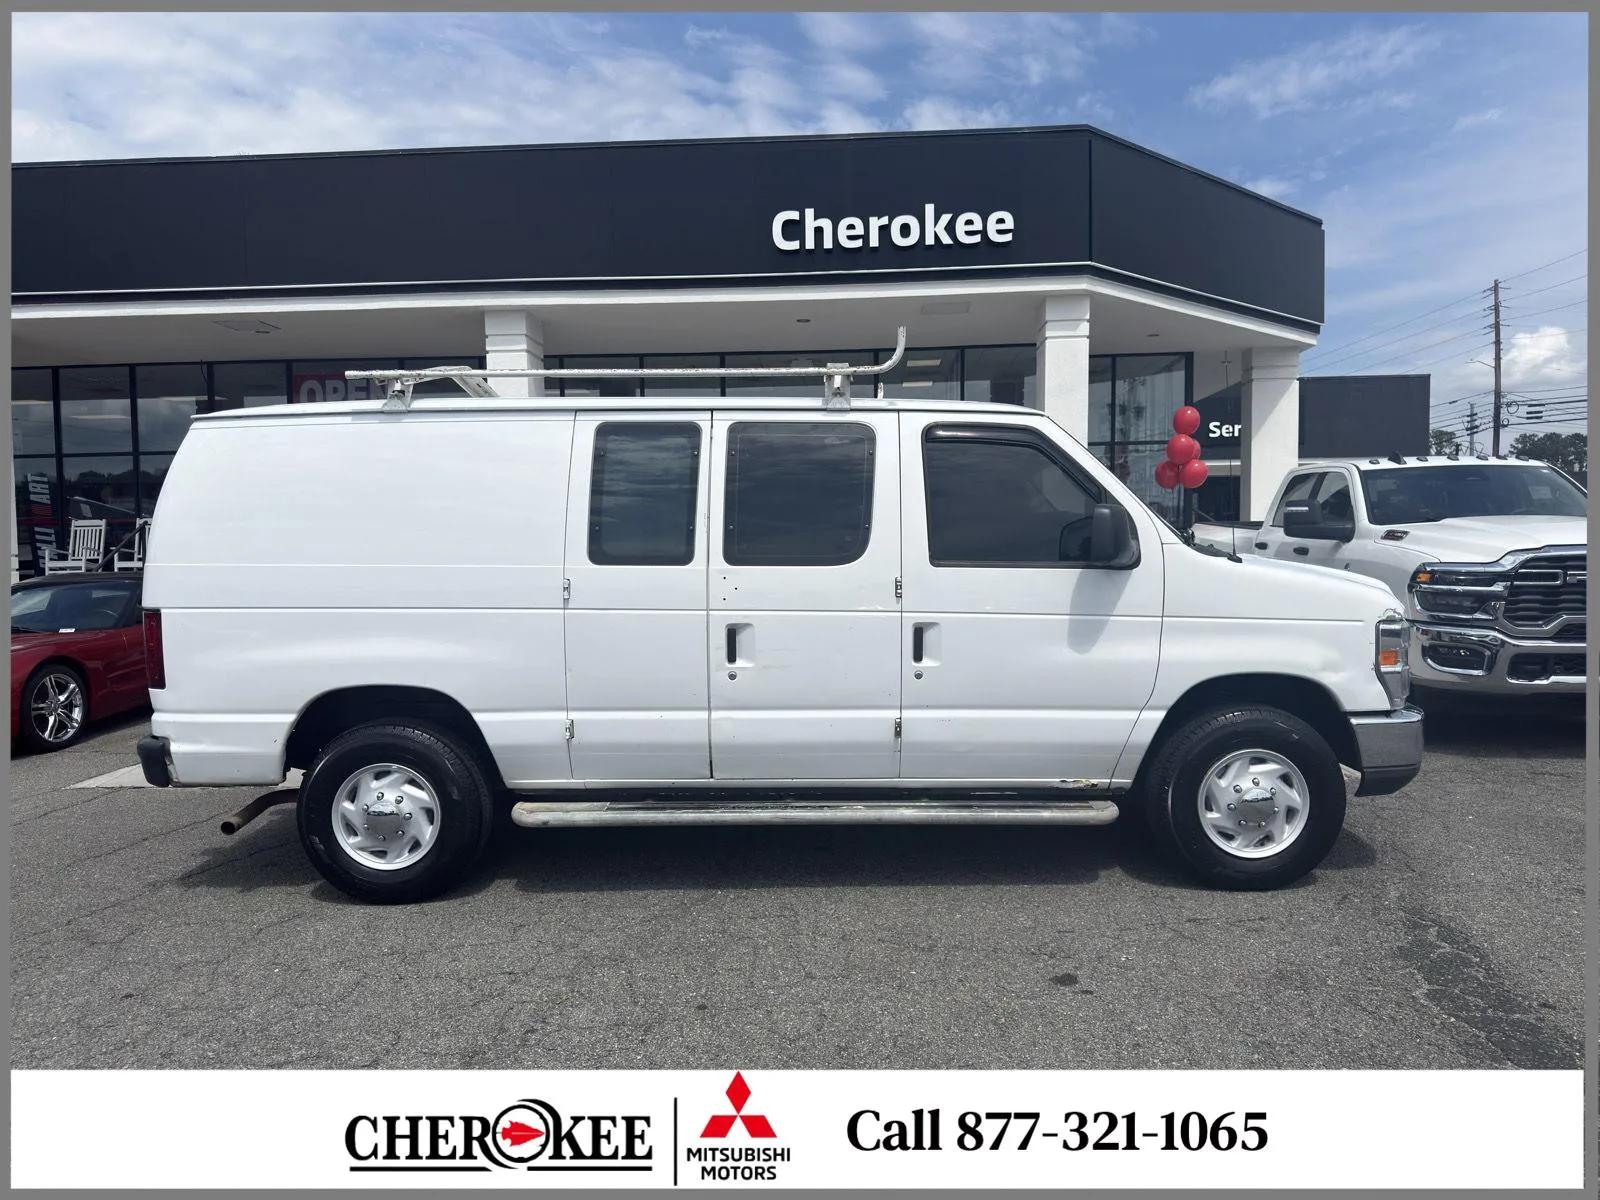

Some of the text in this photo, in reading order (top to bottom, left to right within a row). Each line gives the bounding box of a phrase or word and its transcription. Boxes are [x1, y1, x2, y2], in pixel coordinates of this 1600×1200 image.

[772, 203, 1015, 250] Cherokee
[1208, 421, 1242, 438] Ser
[27, 473, 51, 504] ART
